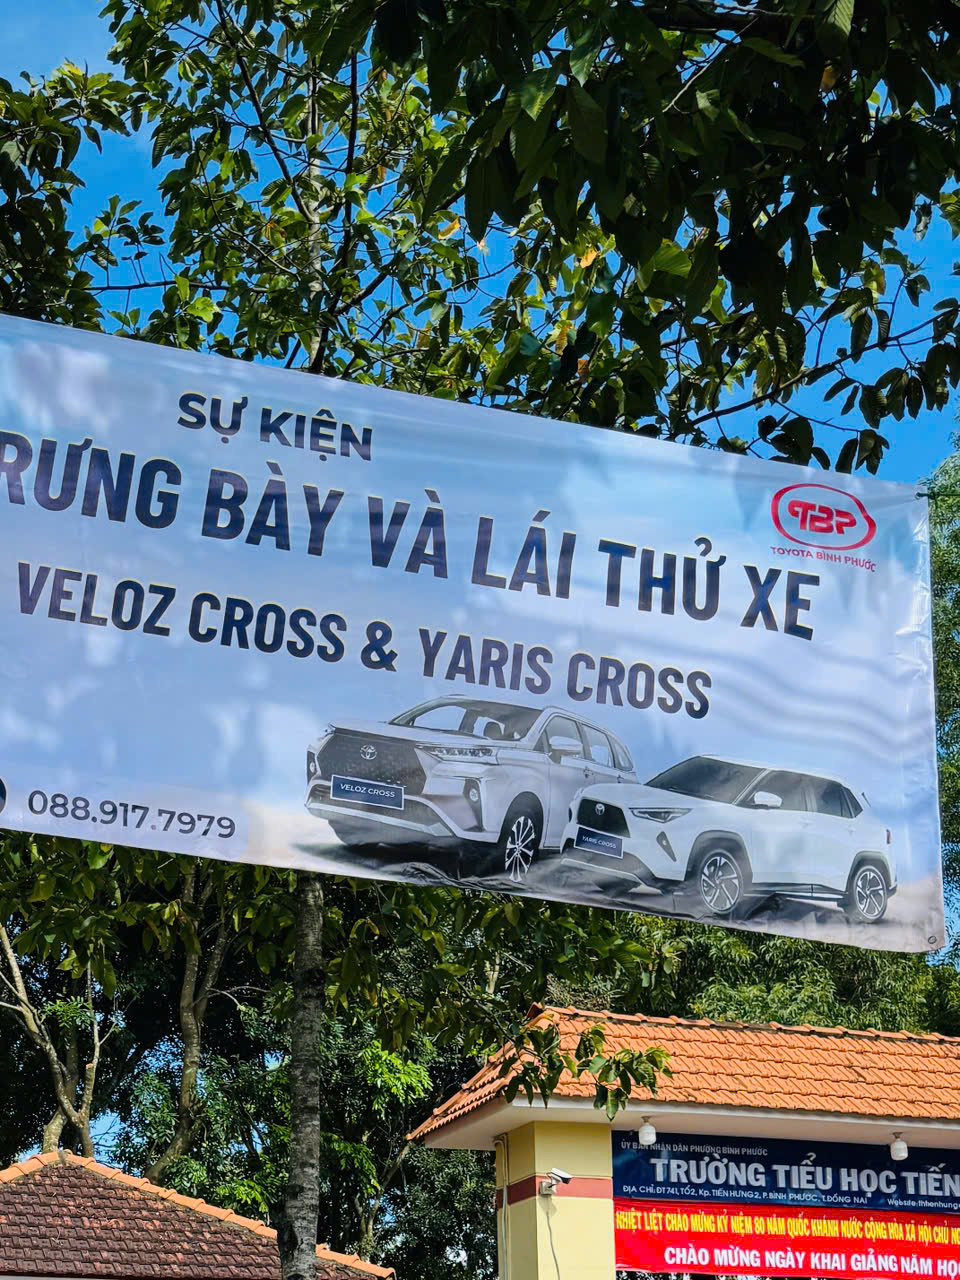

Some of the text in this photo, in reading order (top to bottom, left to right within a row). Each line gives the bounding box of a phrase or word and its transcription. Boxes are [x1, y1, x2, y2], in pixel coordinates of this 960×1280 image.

[178, 393, 372, 461] SỰ KIỆN
[788, 500, 856, 534] TBP
[201, 461, 344, 557] BÀY
[368, 488, 448, 578] VÀ
[471, 509, 577, 600] LÁI
[598, 537, 726, 621] THỬ
[741, 565, 820, 641] XE
[770, 547, 876, 572] TOYOTA BÌNH PHƯỚC
[18, 561, 712, 720] VELOZ CROSS & YARIS CROSS
[340, 783, 395, 798] VELOZ CROSS
[28, 789, 237, 840] 088.917.7979
[673, 1143, 688, 1152] DÂN
[623, 1185, 637, 1194] ĐỊA
[650, 1152, 960, 1197] TRƯỜNG TIỂU HỌC TIẾN
[616, 1207, 641, 1233] NHIỆT
[644, 1208, 662, 1234] LIỆT
[666, 1208, 688, 1232] CHÀO
[690, 1209, 715, 1232] MỪNG
[717, 1209, 728, 1232] KỶ
[731, 1211, 752, 1237] NIỆM
[754, 1216, 765, 1234] 80
[767, 1214, 785, 1235] NĂM
[787, 1211, 810, 1238] QUỐC
[811, 1214, 839, 1236] KHÁNH
[841, 1216, 862, 1238] NƯỚC
[864, 1217, 887, 1242] CỘNG
[905, 1220, 916, 1241] XÃ
[918, 1220, 932, 1246] HỘI
[933, 1220, 948, 1244] CHỦ
[664, 1243, 709, 1265] CHÀO
[714, 1245, 760, 1267] MỪNG
[765, 1247, 805, 1268] NGÀY
[810, 1253, 846, 1270] KHAI
[850, 1248, 898, 1272] GIẢNG
[901, 1254, 933, 1275] NĂM
